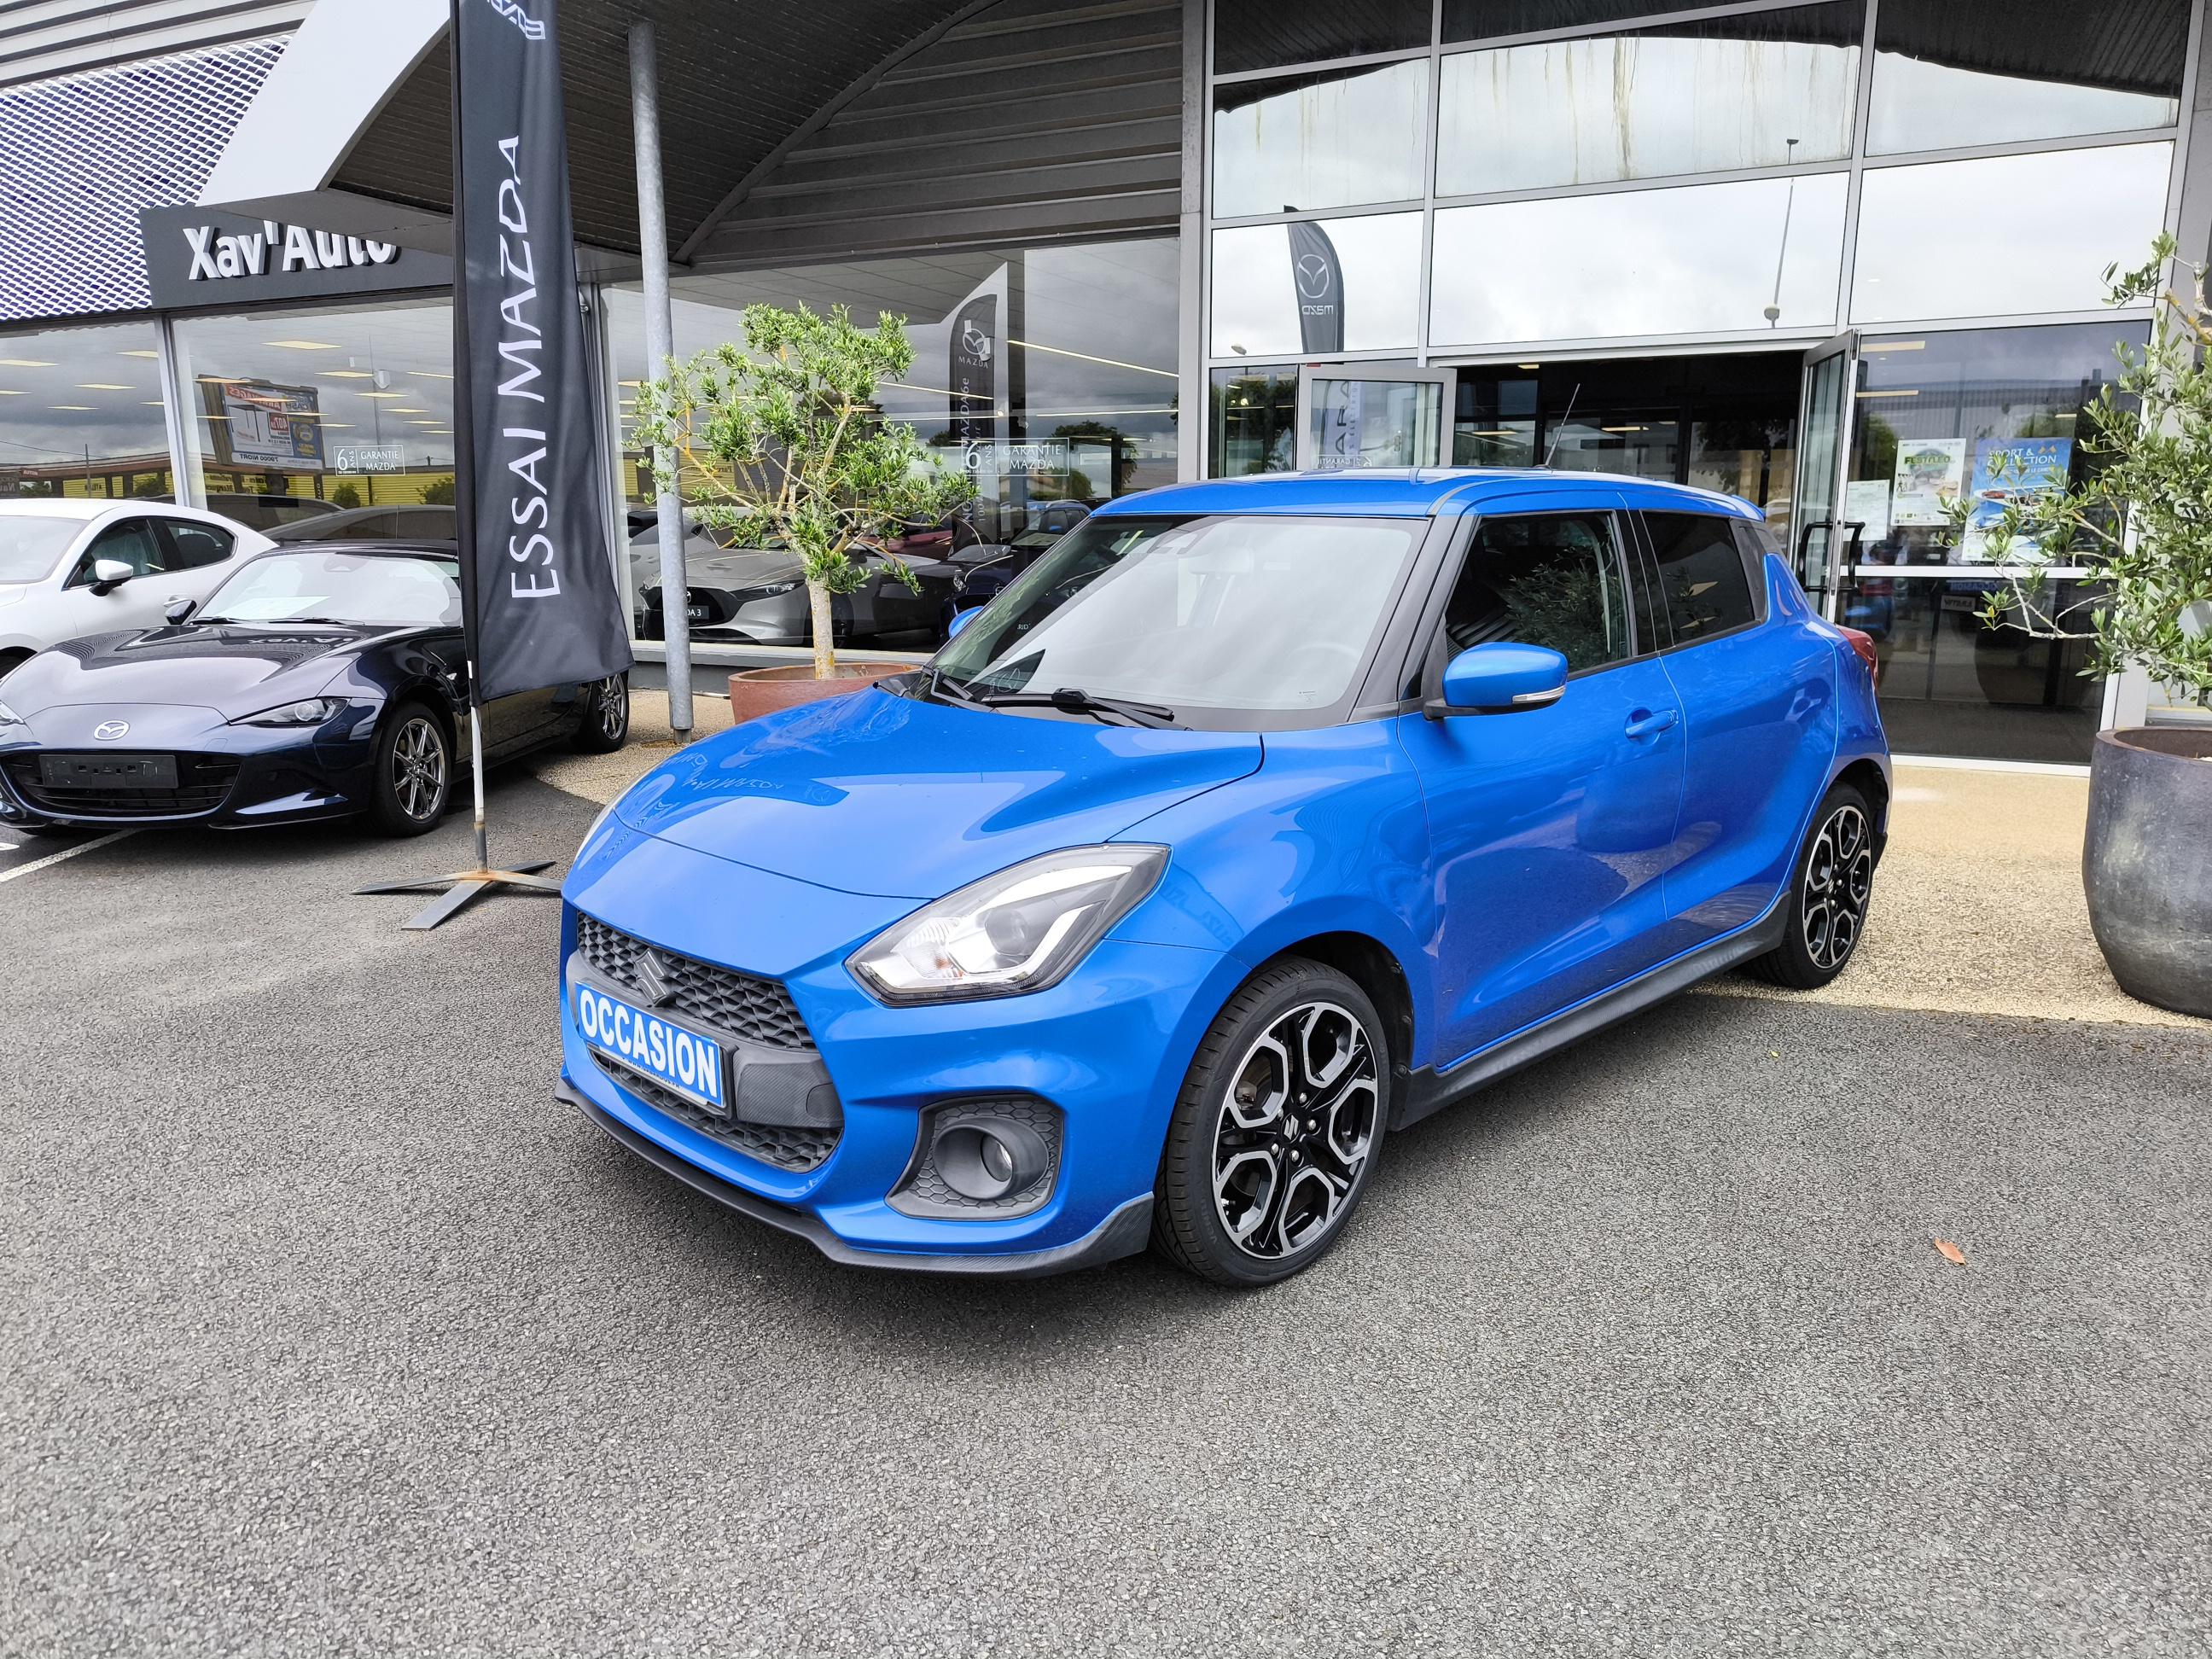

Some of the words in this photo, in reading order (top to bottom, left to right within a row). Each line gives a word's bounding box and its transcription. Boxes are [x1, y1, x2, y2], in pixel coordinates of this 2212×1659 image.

[183, 219, 397, 281] Xav'Auto
[498, 136, 544, 403] MAZDA
[958, 356, 988, 369] MAZDA
[337, 448, 348, 471] 6
[348, 451, 357, 469] ANS
[360, 451, 399, 460] GARANTIE
[965, 440, 982, 469] 6
[985, 443, 993, 466] ANS
[1002, 444, 1062, 456] GARANTIE
[365, 462, 396, 471] MAZDA
[1009, 459, 1055, 470] MAZDA
[503, 428, 561, 598] ESSAI
[579, 989, 718, 1098] OCCASION
